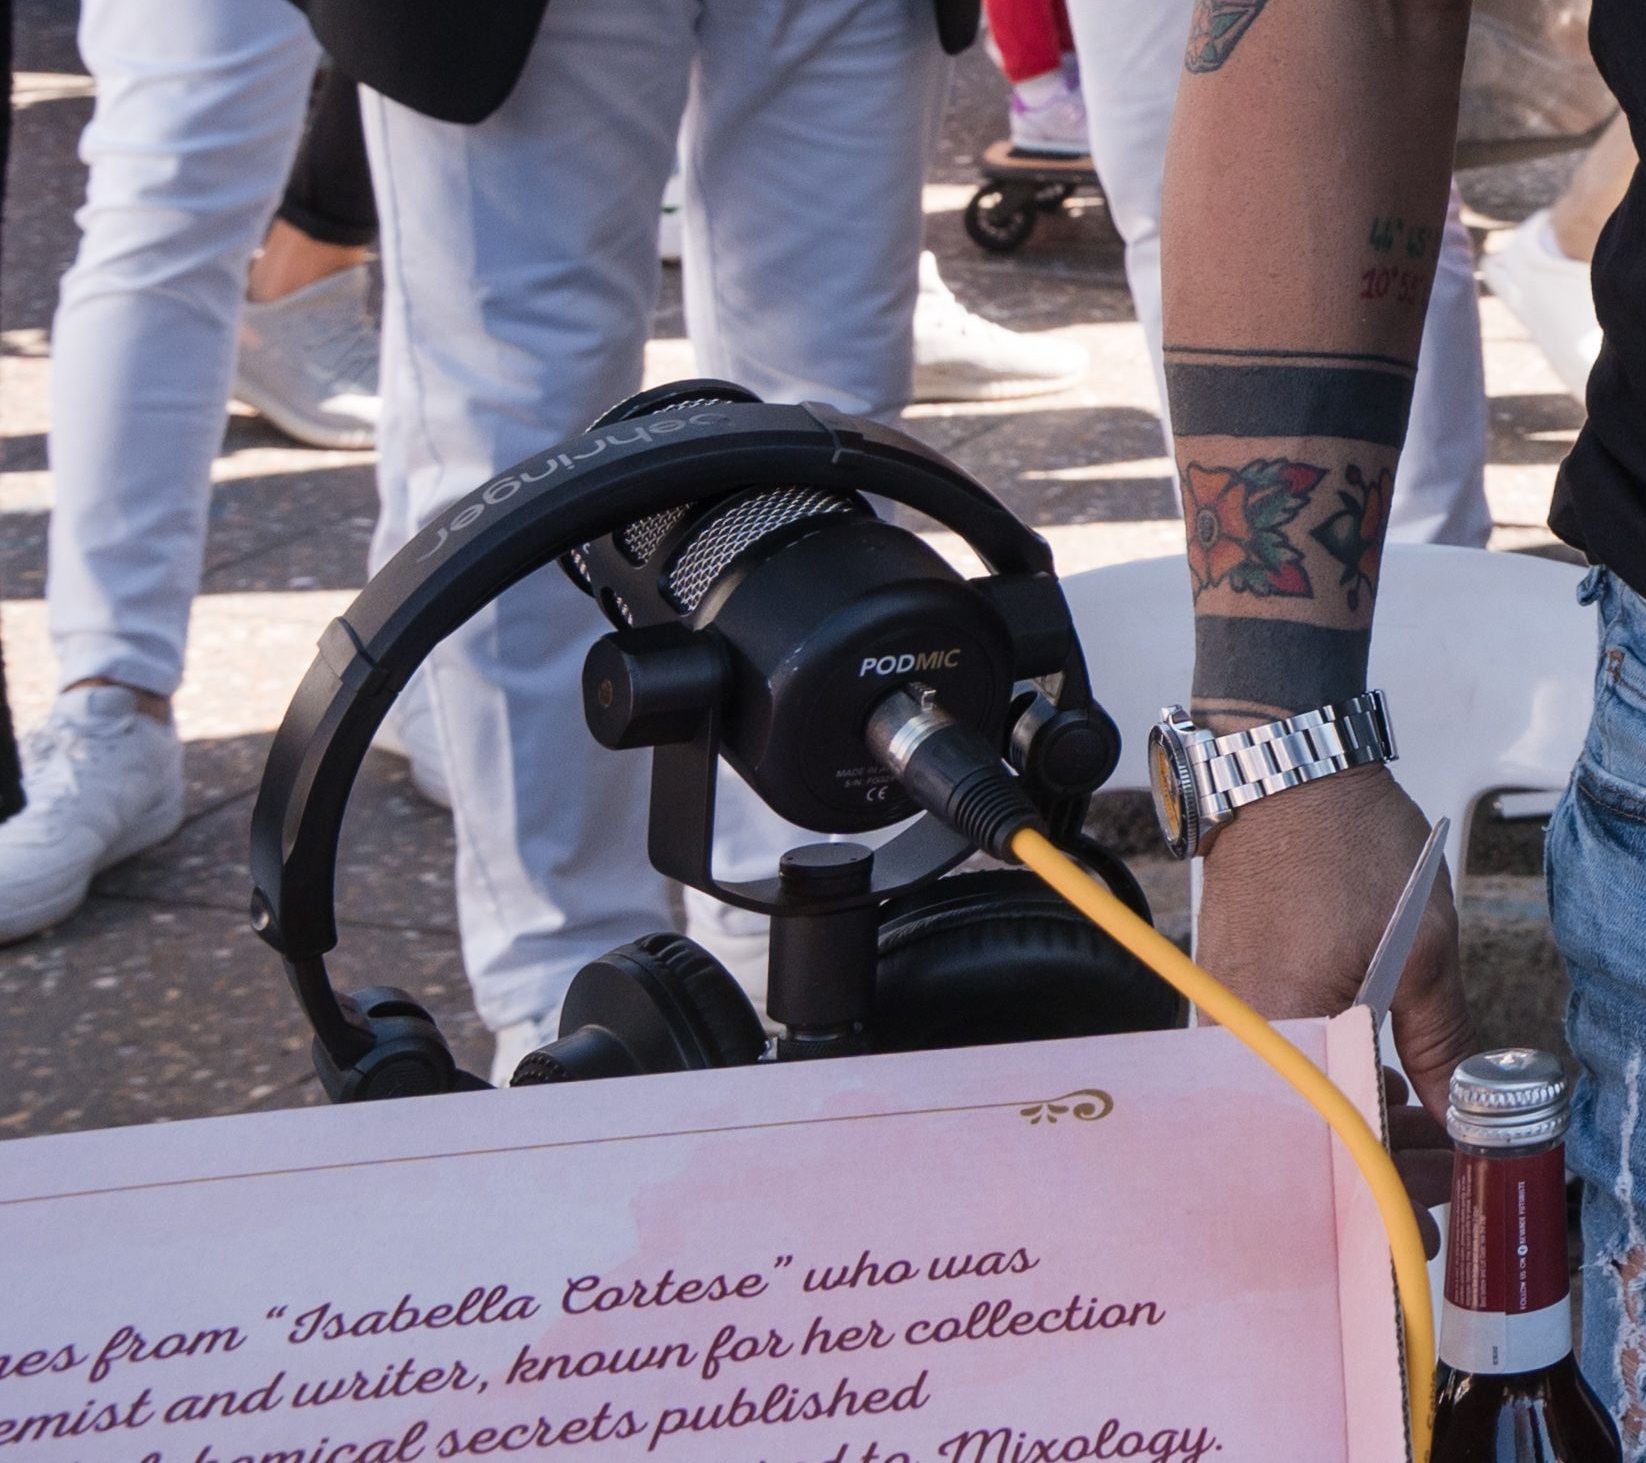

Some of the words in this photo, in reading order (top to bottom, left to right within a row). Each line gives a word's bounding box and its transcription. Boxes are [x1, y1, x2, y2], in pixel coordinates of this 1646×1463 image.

[859, 648, 961, 678] PODMIC
[88, 1325, 248, 1383] from
[802, 1250, 920, 1293] who
[927, 1247, 1039, 1280] was
[163, 1370, 284, 1424] and
[292, 1358, 489, 1409] writer,
[505, 1339, 699, 1385] known
[702, 1325, 795, 1380] for
[801, 1316, 896, 1357] her
[903, 1297, 1166, 1344] collection
[435, 1402, 649, 1460] secrets
[648, 1370, 930, 1452] published
